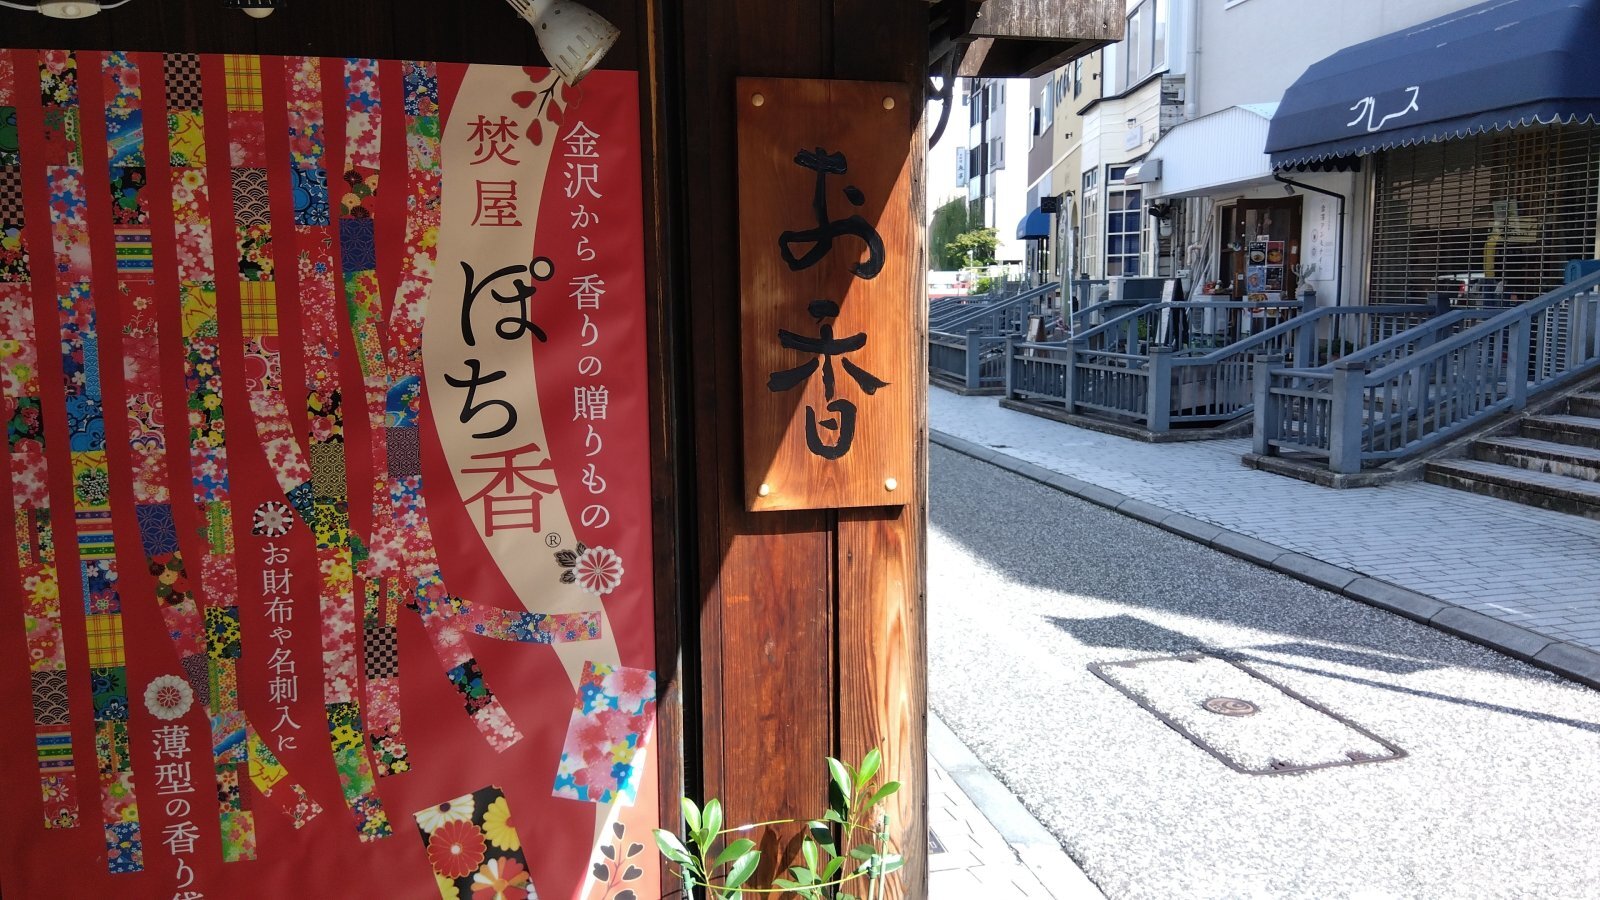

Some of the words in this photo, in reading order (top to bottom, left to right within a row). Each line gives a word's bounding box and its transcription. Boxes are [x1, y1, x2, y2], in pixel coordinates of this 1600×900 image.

[563, 121, 610, 529] 金沢から香りの贈りもの
[767, 147, 891, 460] お香
[262, 542, 301, 751] お財布や名刺入に
[152, 725, 204, 900] 薄型の香り
